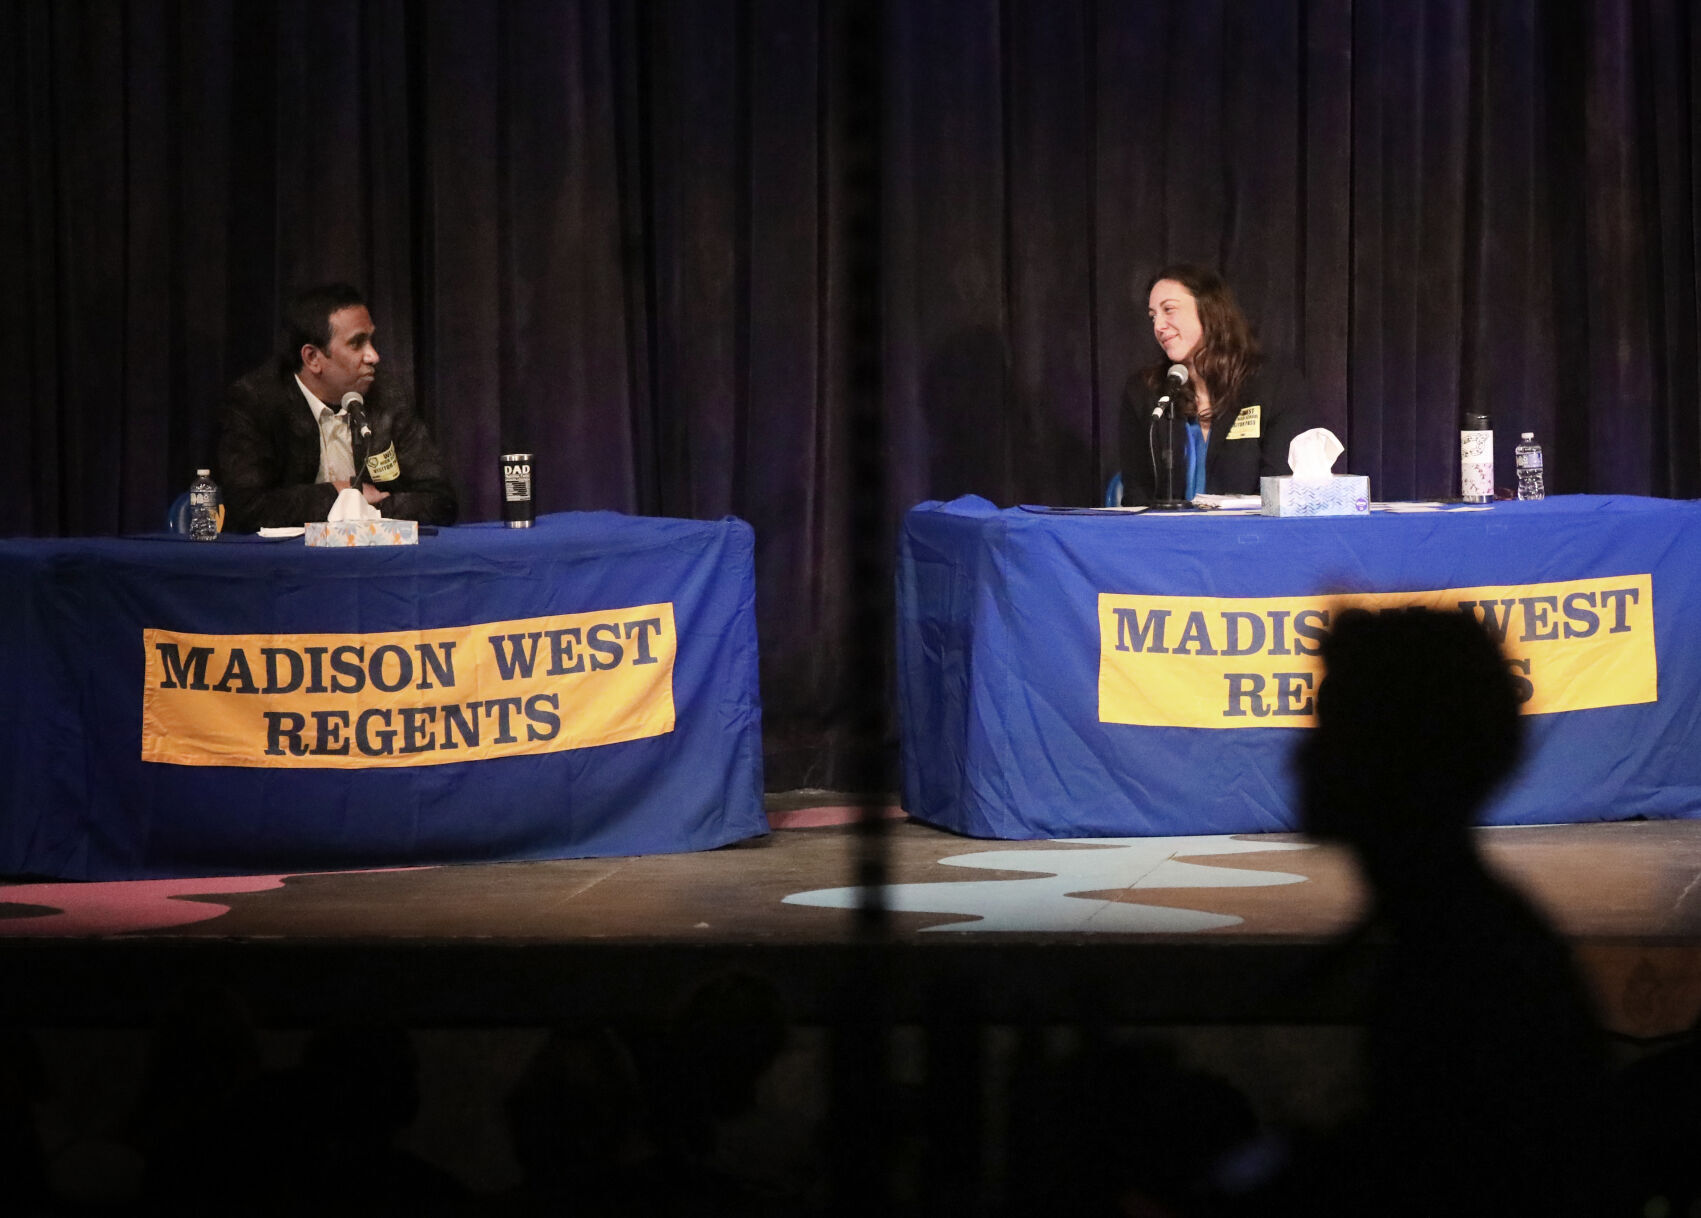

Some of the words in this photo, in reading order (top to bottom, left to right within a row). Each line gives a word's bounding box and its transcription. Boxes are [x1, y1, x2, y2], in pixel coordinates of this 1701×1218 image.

[504, 465, 530, 475] DAD
[156, 640, 457, 695] MADISON
[488, 616, 662, 680] WEST
[1112, 605, 1426, 657] MADIS
[263, 690, 561, 756] REGENTS
